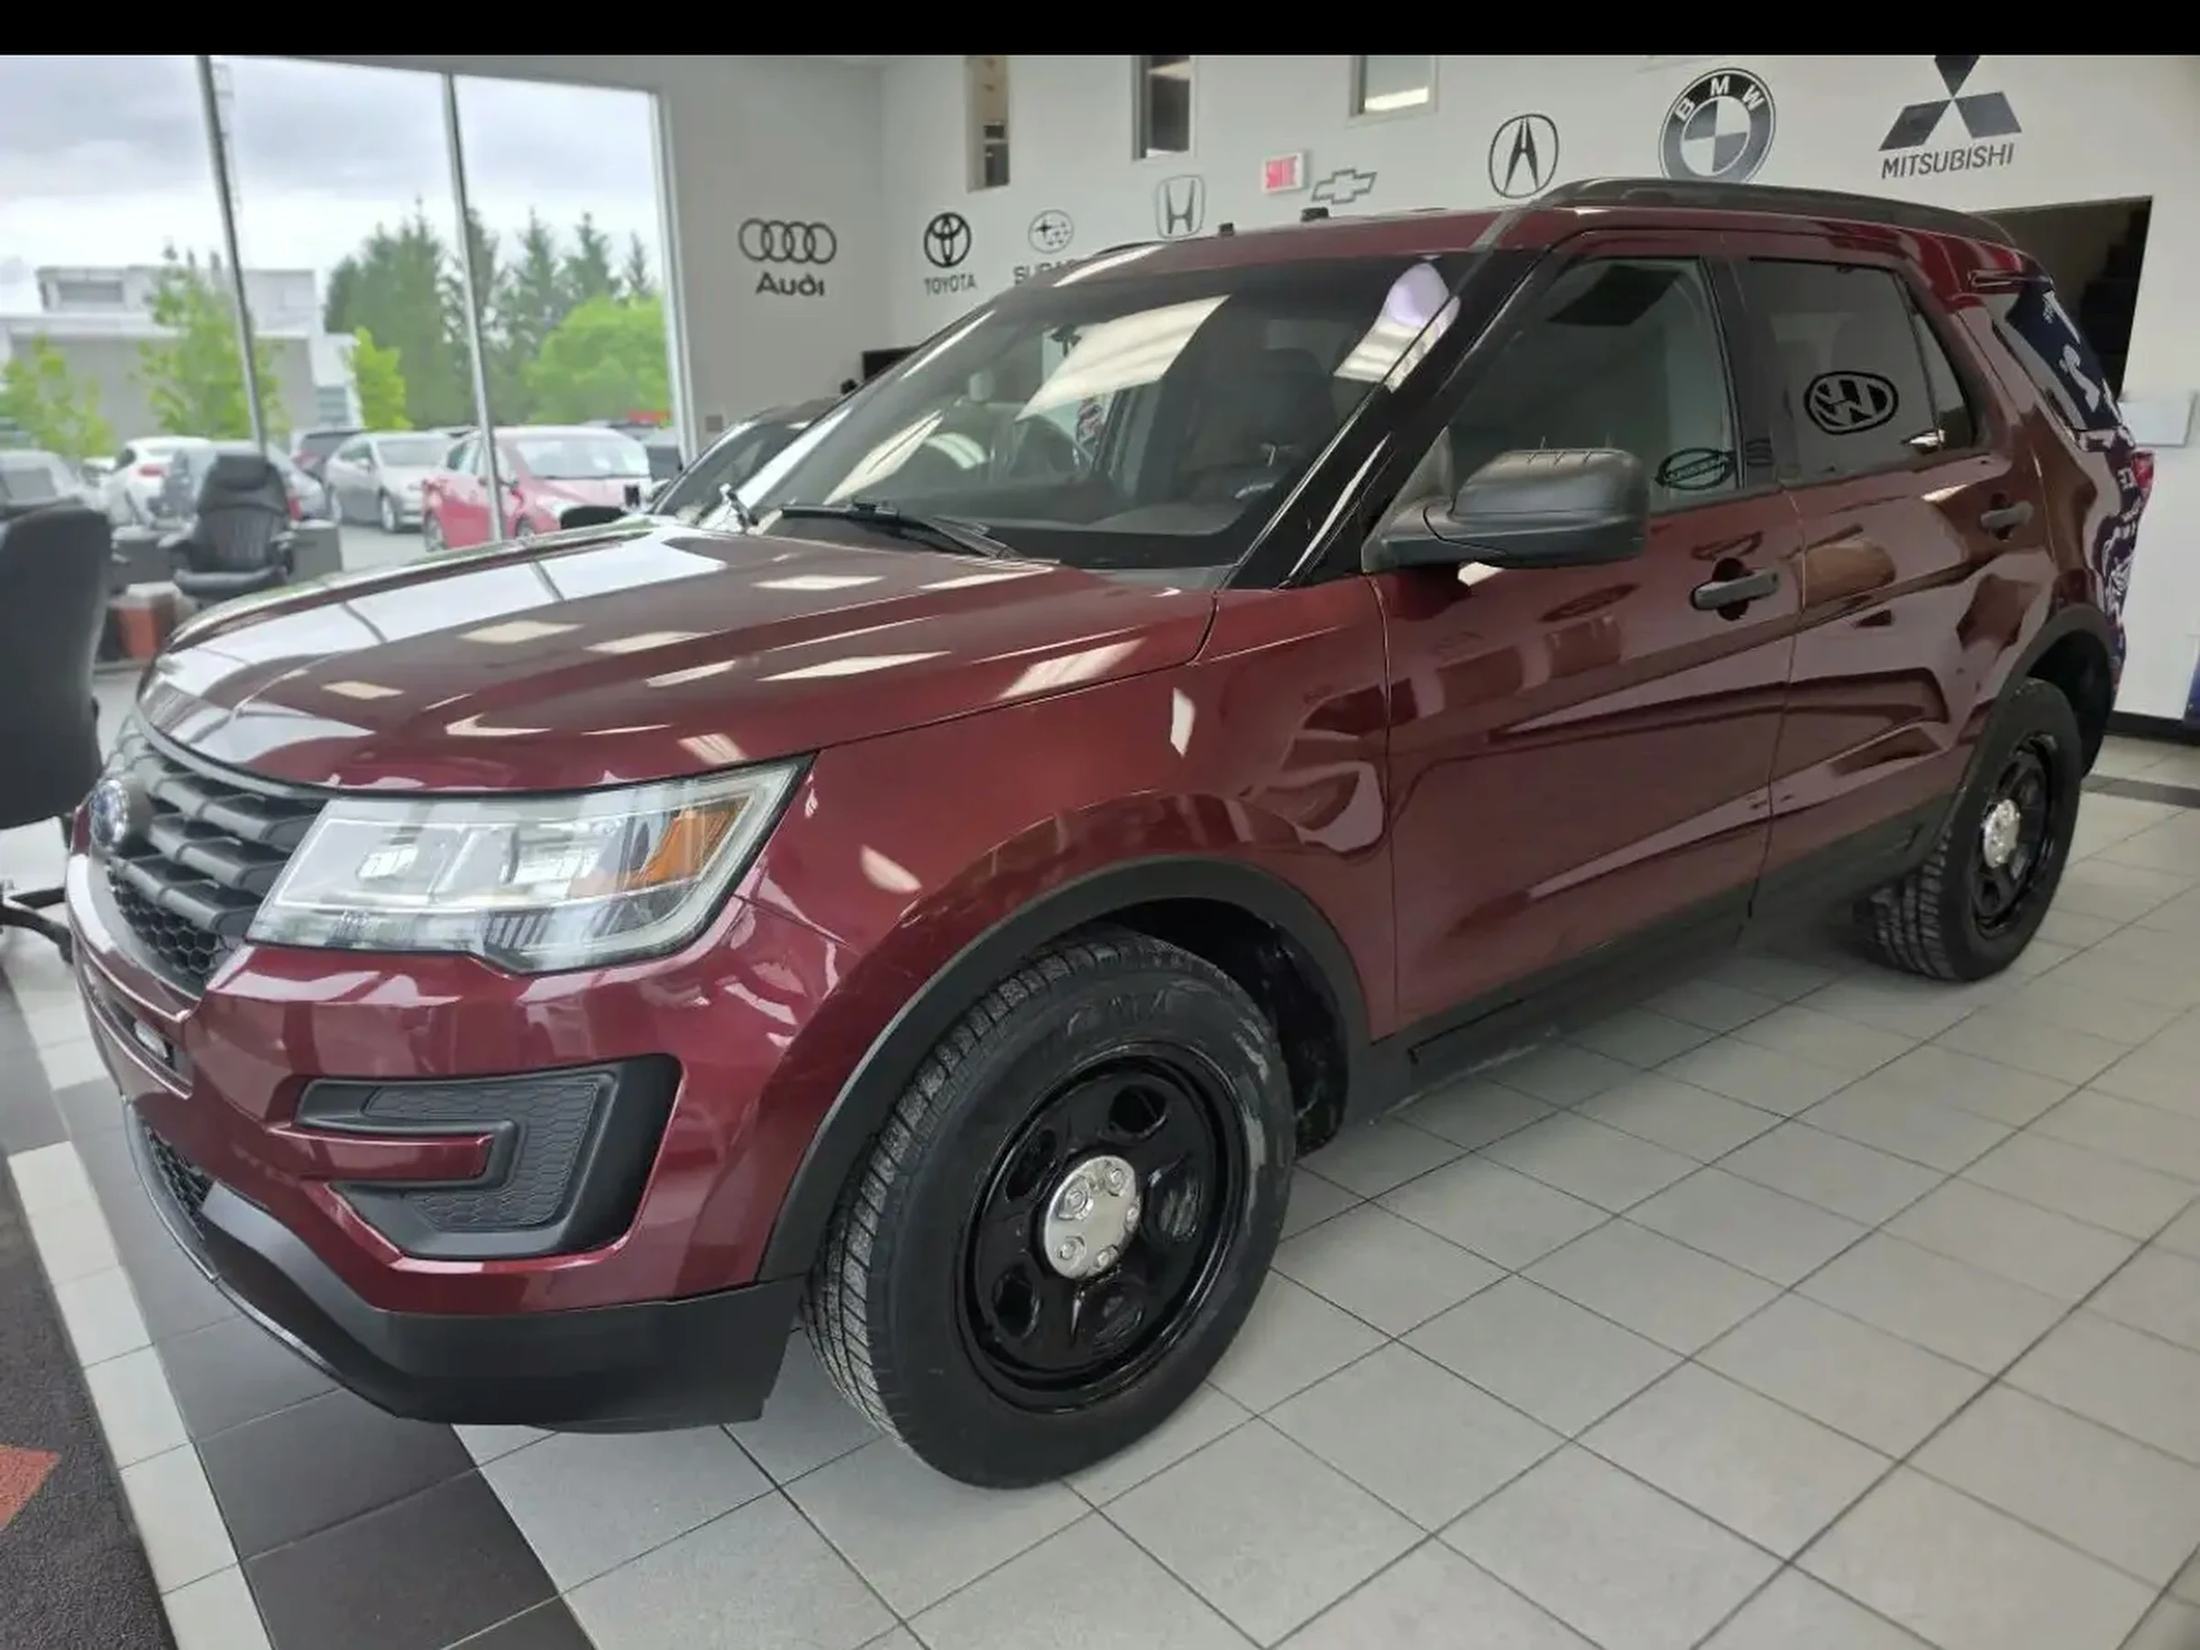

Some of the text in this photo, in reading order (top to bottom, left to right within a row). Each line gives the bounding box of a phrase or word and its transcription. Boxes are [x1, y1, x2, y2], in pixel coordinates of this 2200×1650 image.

[1673, 75, 1766, 122] BMW
[1881, 143, 2015, 179] MITSUBISHI
[755, 271, 825, 296] Audi
[924, 273, 977, 296] TOYOTA
